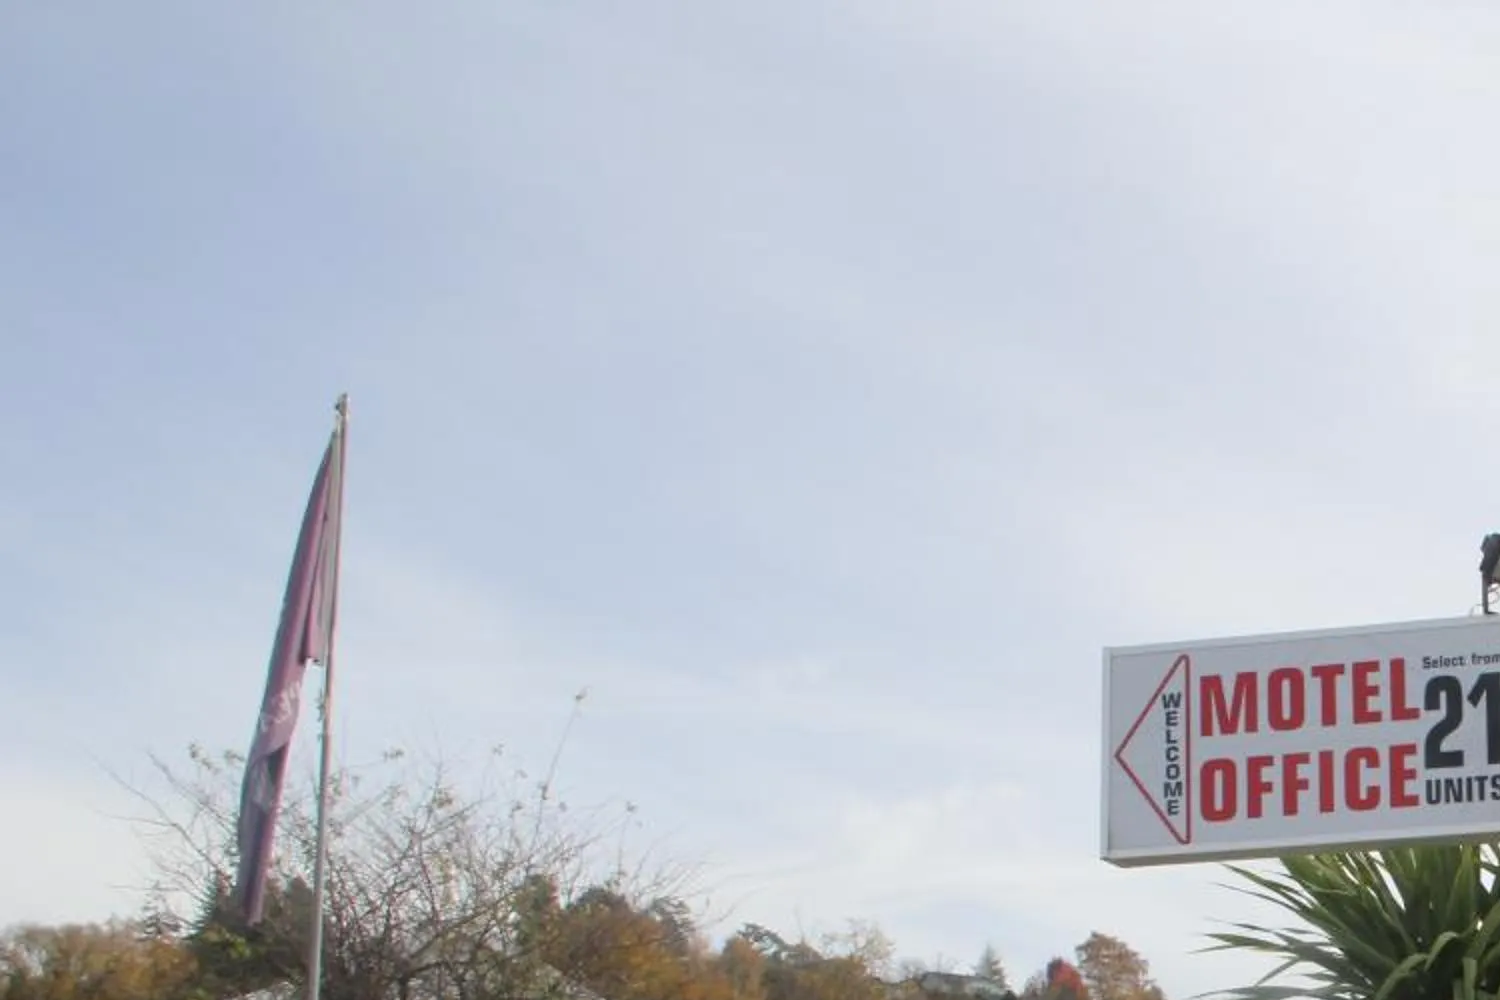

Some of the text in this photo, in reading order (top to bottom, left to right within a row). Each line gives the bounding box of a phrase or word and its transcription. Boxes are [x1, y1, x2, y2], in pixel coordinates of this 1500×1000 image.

[1199, 656, 1420, 737] MOTEL
[1421, 655, 1467, 669] Select
[1161, 691, 1183, 816] WELCOME
[1199, 743, 1420, 824] OFFICE
